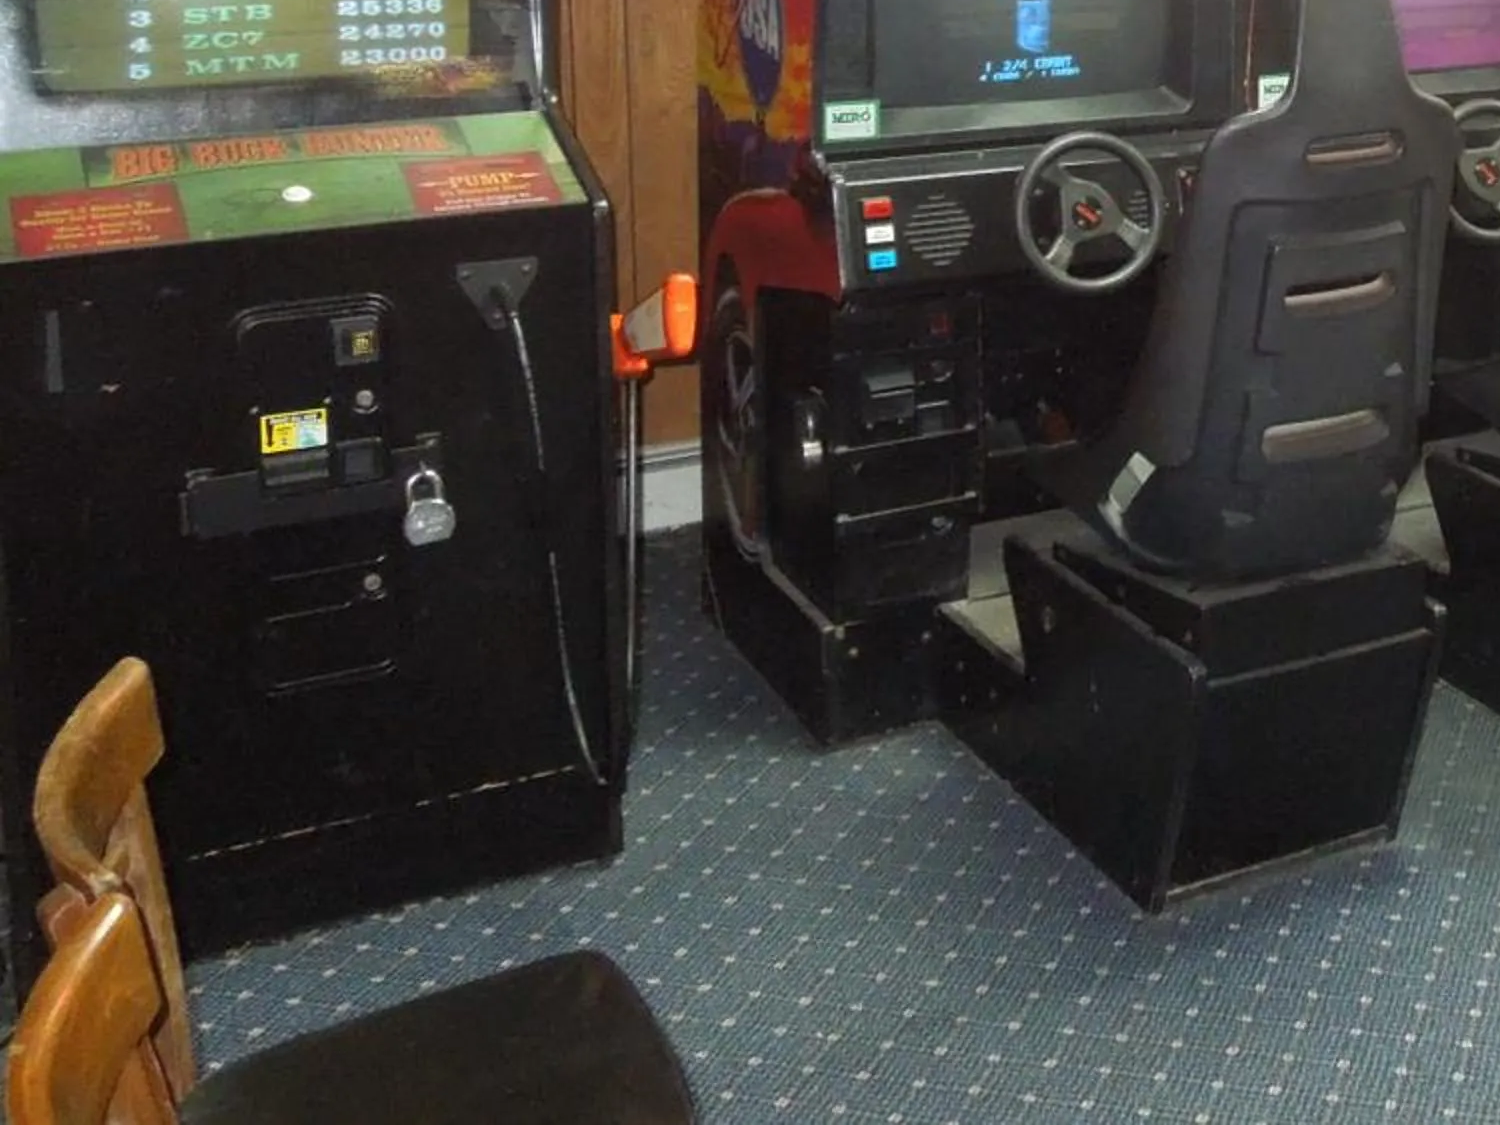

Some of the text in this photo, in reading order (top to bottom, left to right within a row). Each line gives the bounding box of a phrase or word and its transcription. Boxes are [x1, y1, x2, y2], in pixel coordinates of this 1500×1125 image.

[129, 9, 153, 28] 3
[183, 4, 274, 26] STB
[129, 36, 152, 54] 4
[339, 22, 446, 42] 24270
[128, 46, 447, 81] 5 MTM 23000
[113, 145, 178, 179] BIG
[448, 171, 514, 190] PUMP
